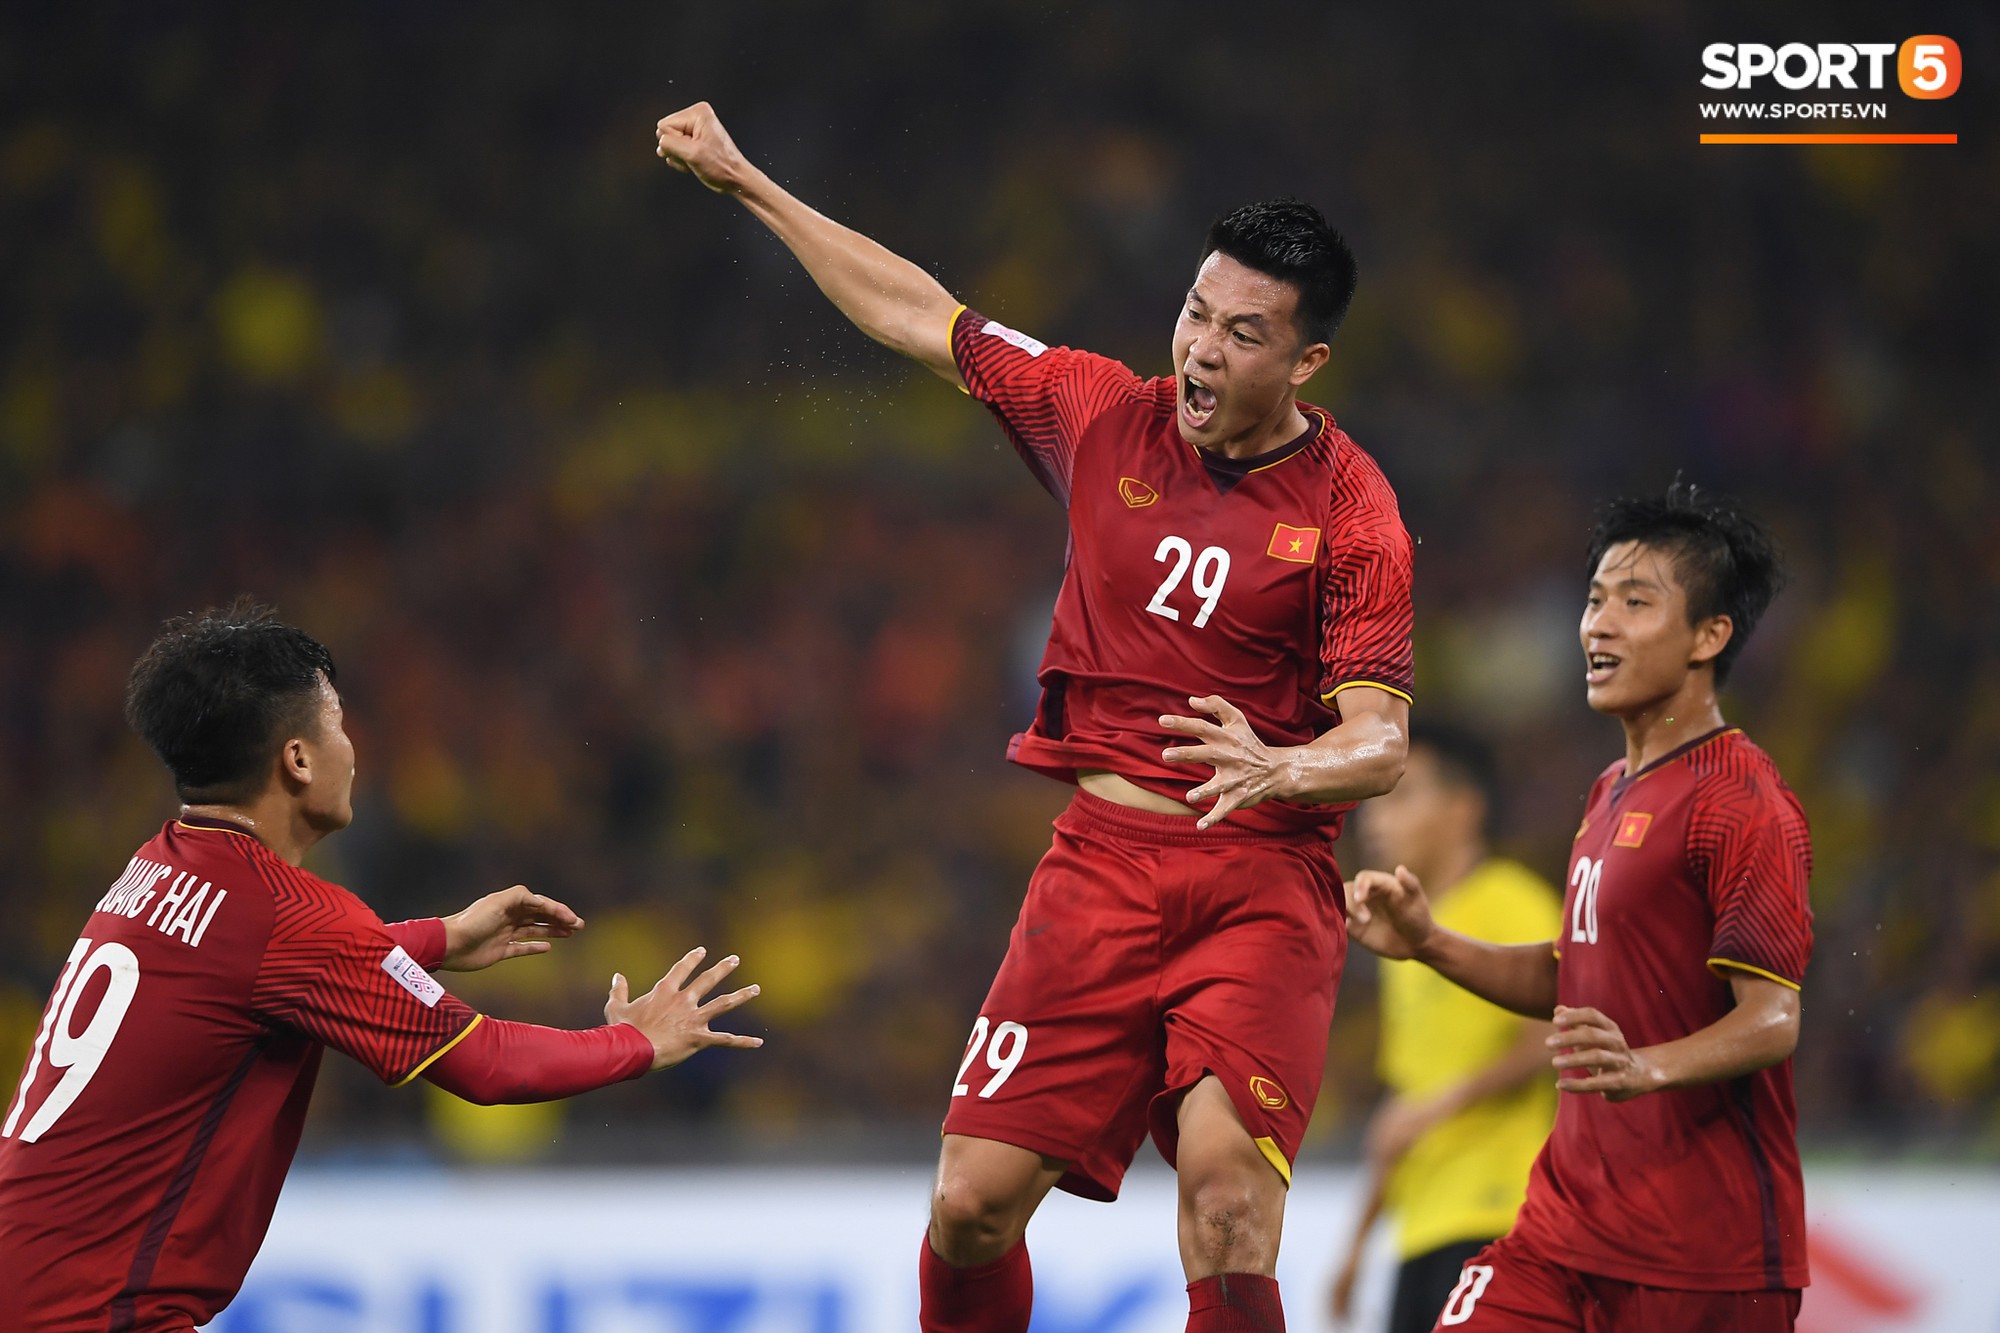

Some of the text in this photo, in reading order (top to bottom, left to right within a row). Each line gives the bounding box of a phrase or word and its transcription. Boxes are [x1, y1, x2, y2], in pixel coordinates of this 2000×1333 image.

[1146, 535, 1231, 629] 29
[147, 871, 228, 948] HAI
[1571, 856, 1604, 945] 20
[2, 938, 140, 1144] 19
[952, 1016, 1028, 1099] 29
